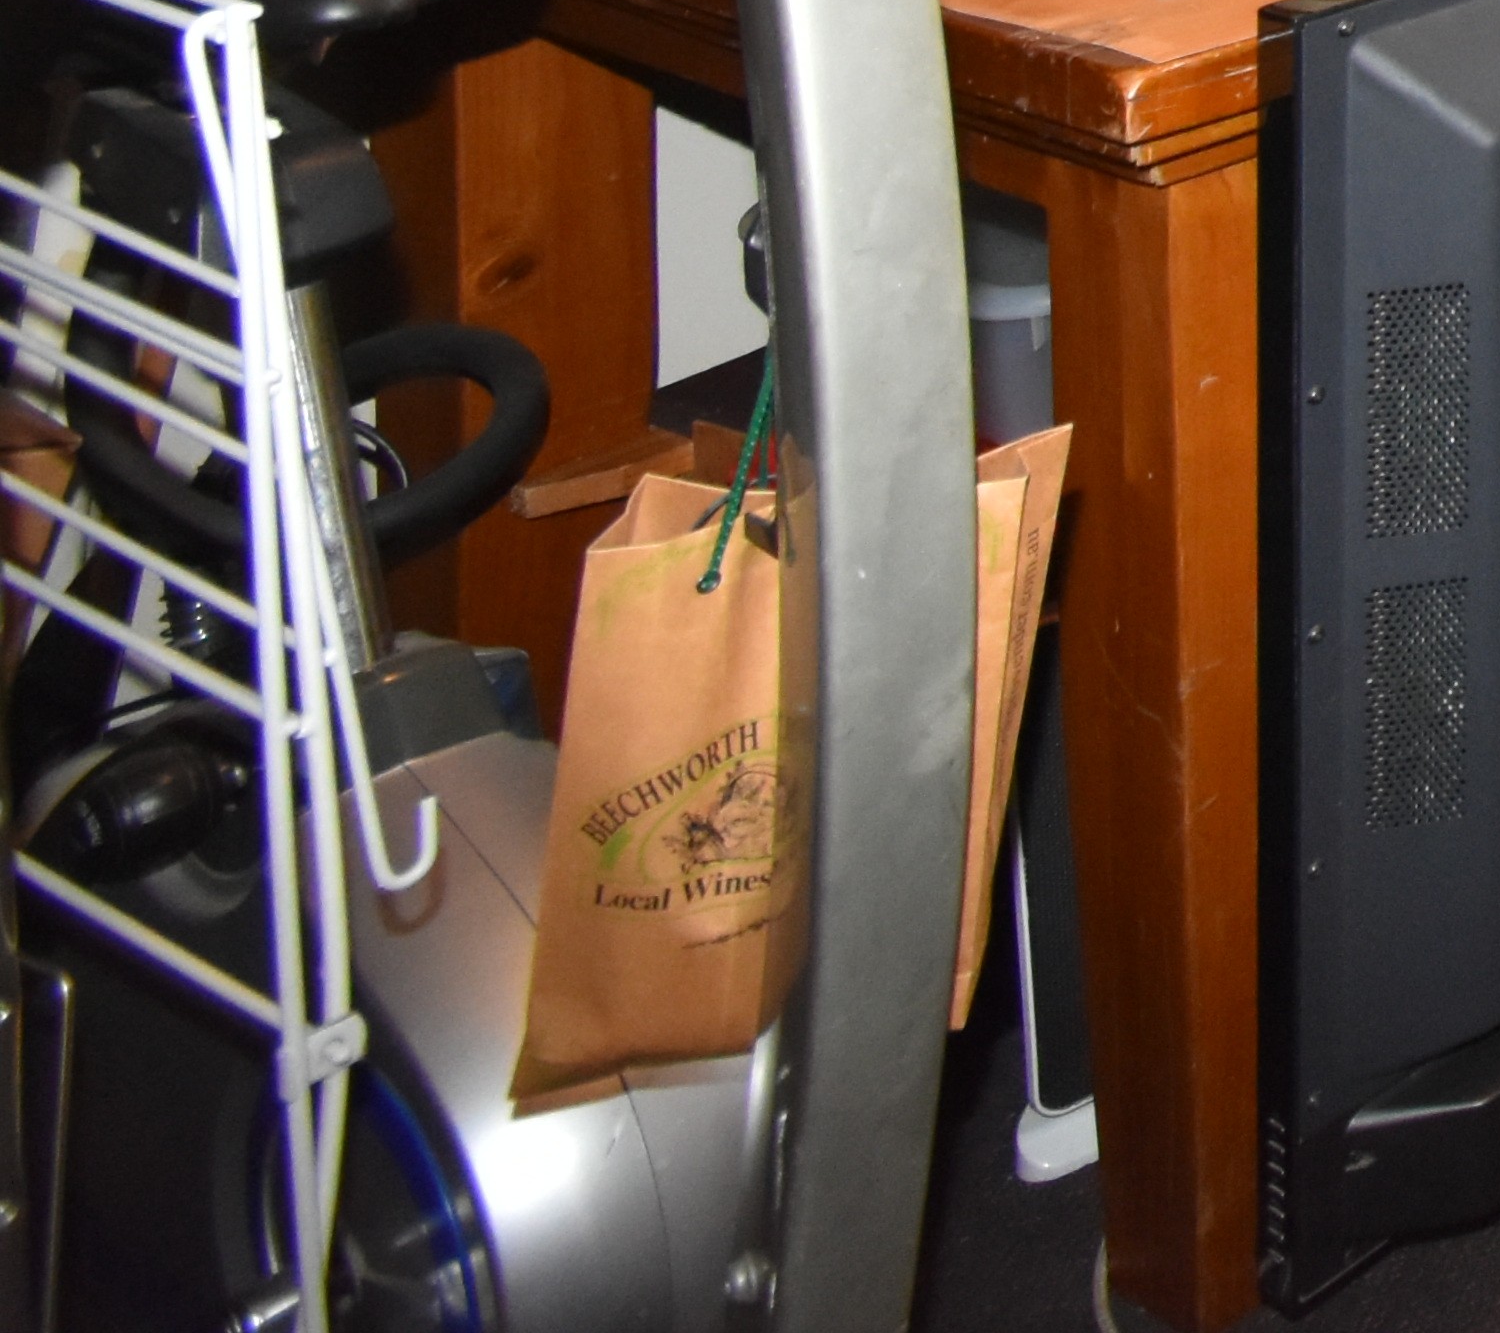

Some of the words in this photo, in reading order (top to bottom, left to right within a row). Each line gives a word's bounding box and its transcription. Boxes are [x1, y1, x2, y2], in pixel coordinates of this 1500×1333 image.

[580, 720, 759, 847] BEECHWORTH
[594, 883, 672, 911] Local
[683, 871, 772, 903] Wines
